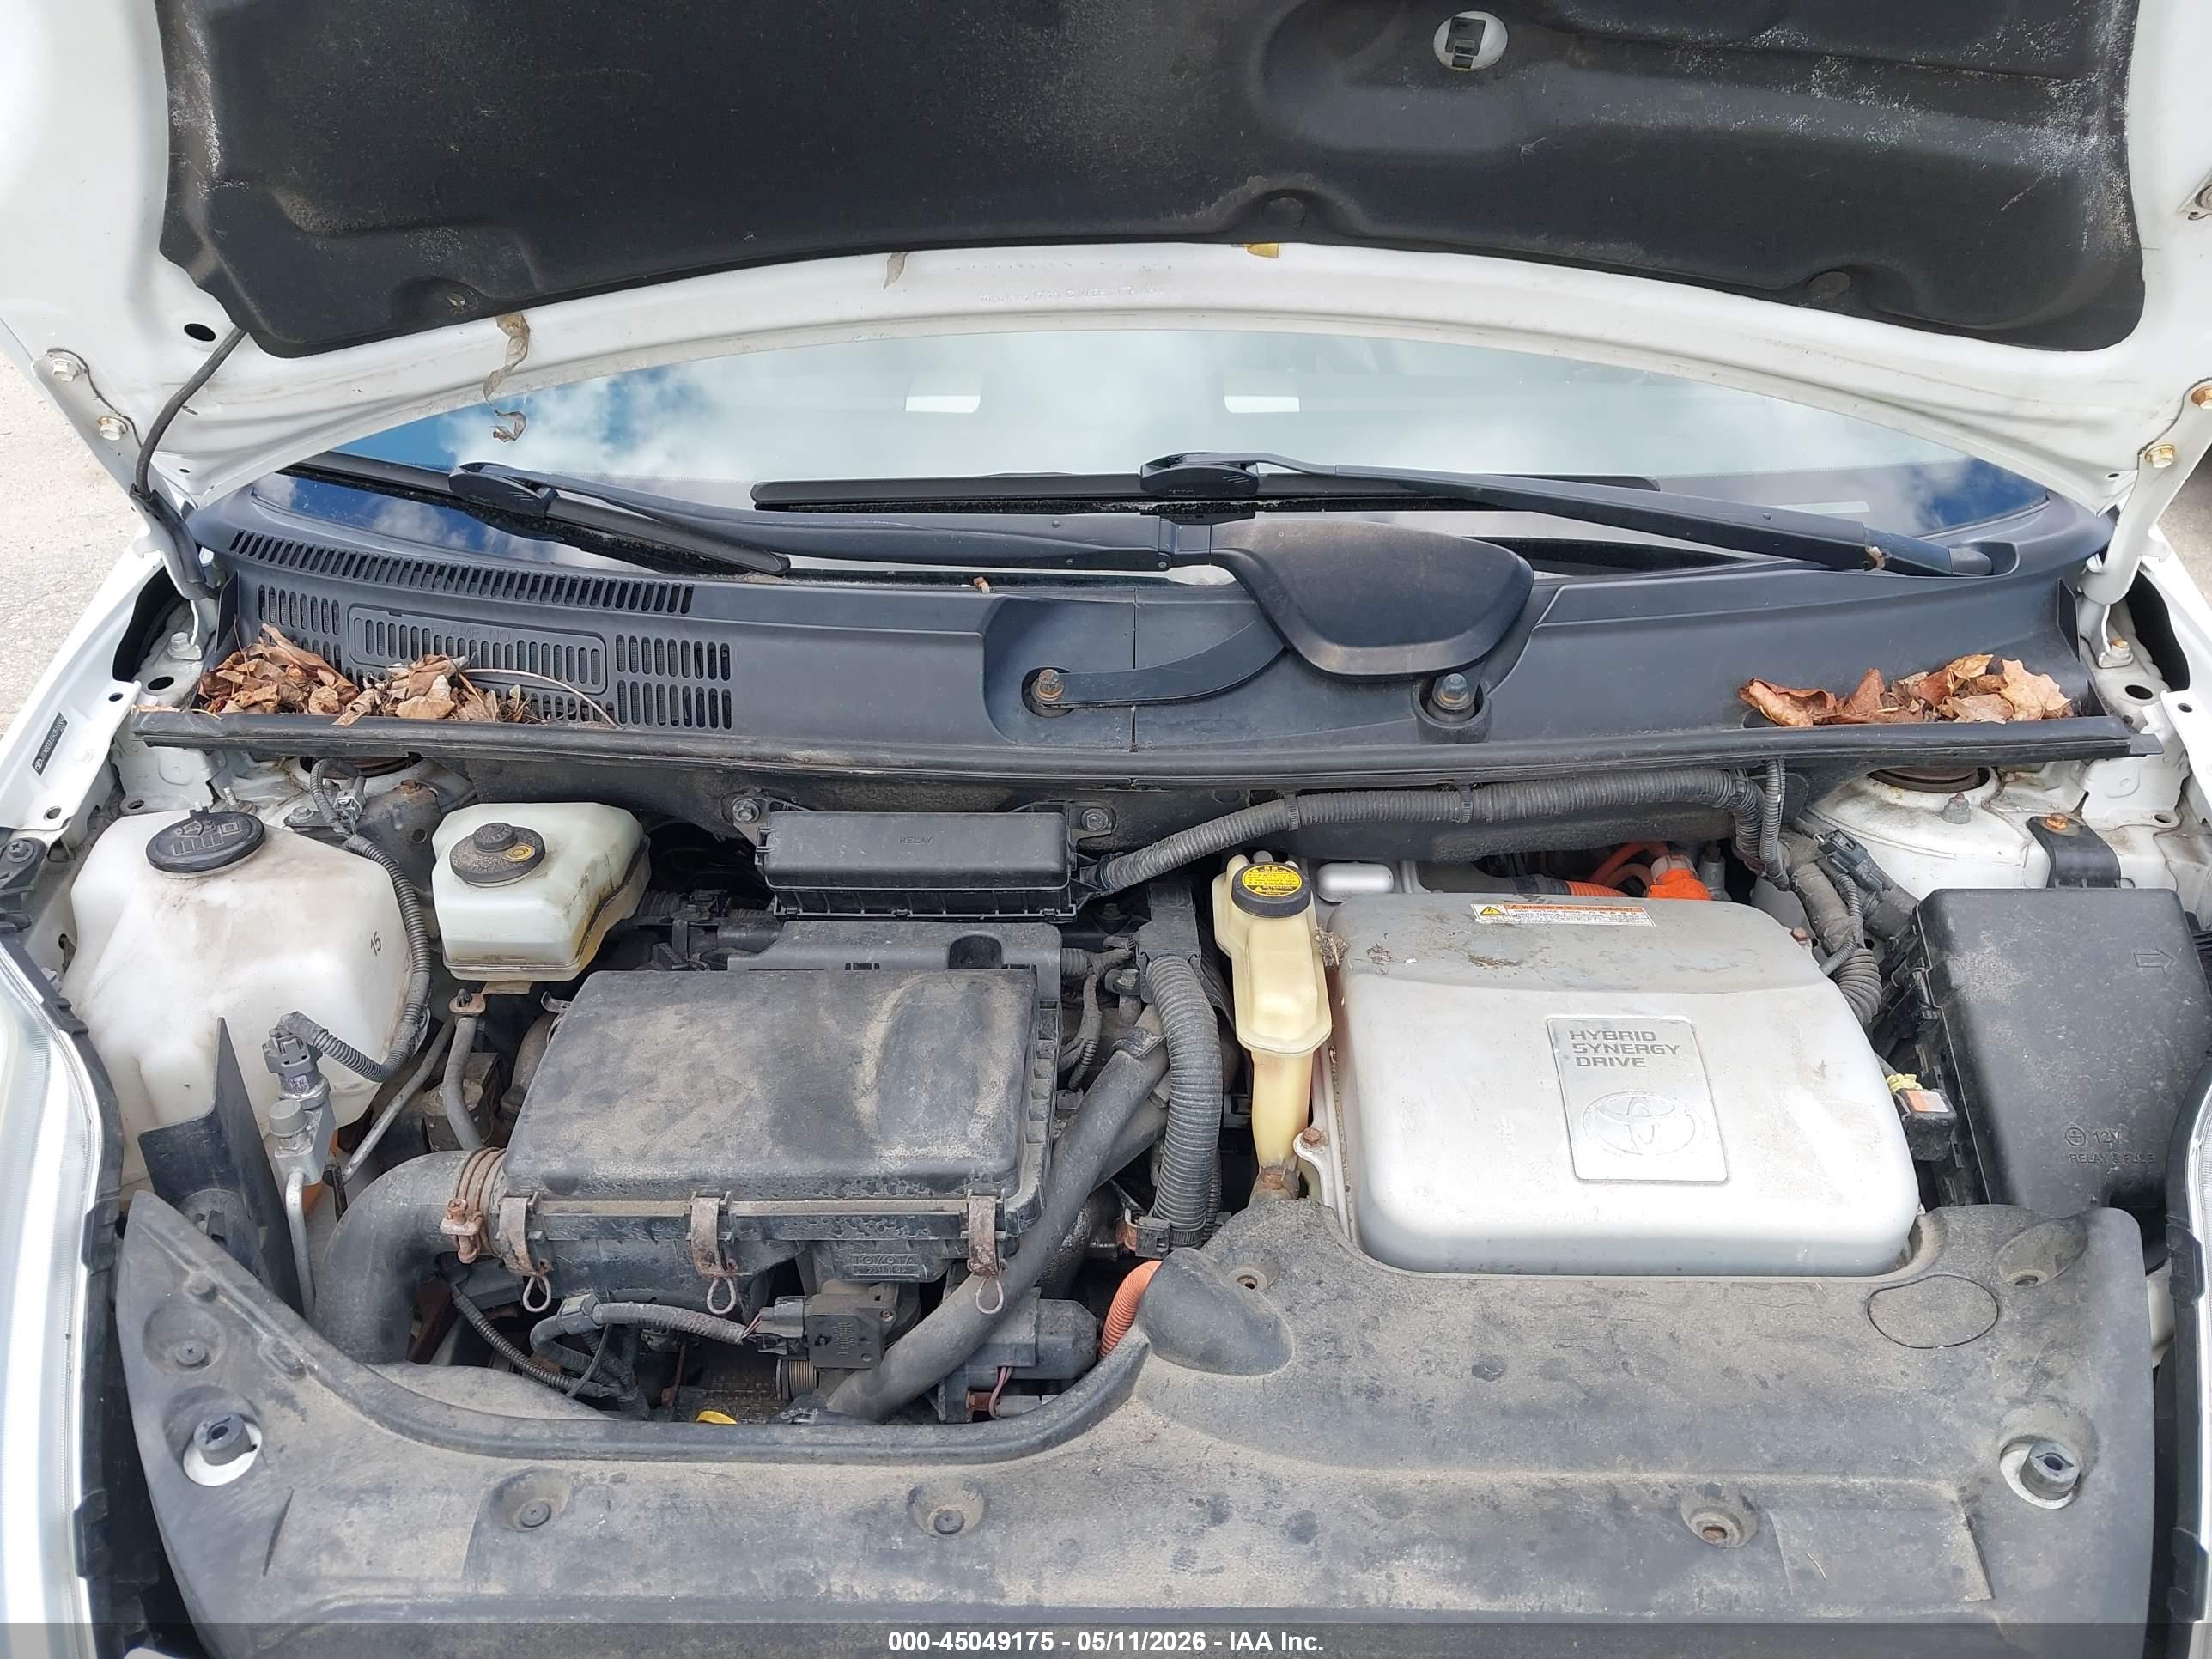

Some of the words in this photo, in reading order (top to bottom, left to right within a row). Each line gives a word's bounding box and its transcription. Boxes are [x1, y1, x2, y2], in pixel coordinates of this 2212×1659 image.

[899, 836, 934, 845] RELAY
[370, 930, 382, 957] 15
[1569, 1030, 1656, 1042] HYBRID
[1572, 1042, 1680, 1055] SYNERGY
[1576, 1056, 1647, 1068] DRIVE
[2093, 1129, 2121, 1144] 12V
[853, 1255, 917, 1264] TOYOTA
